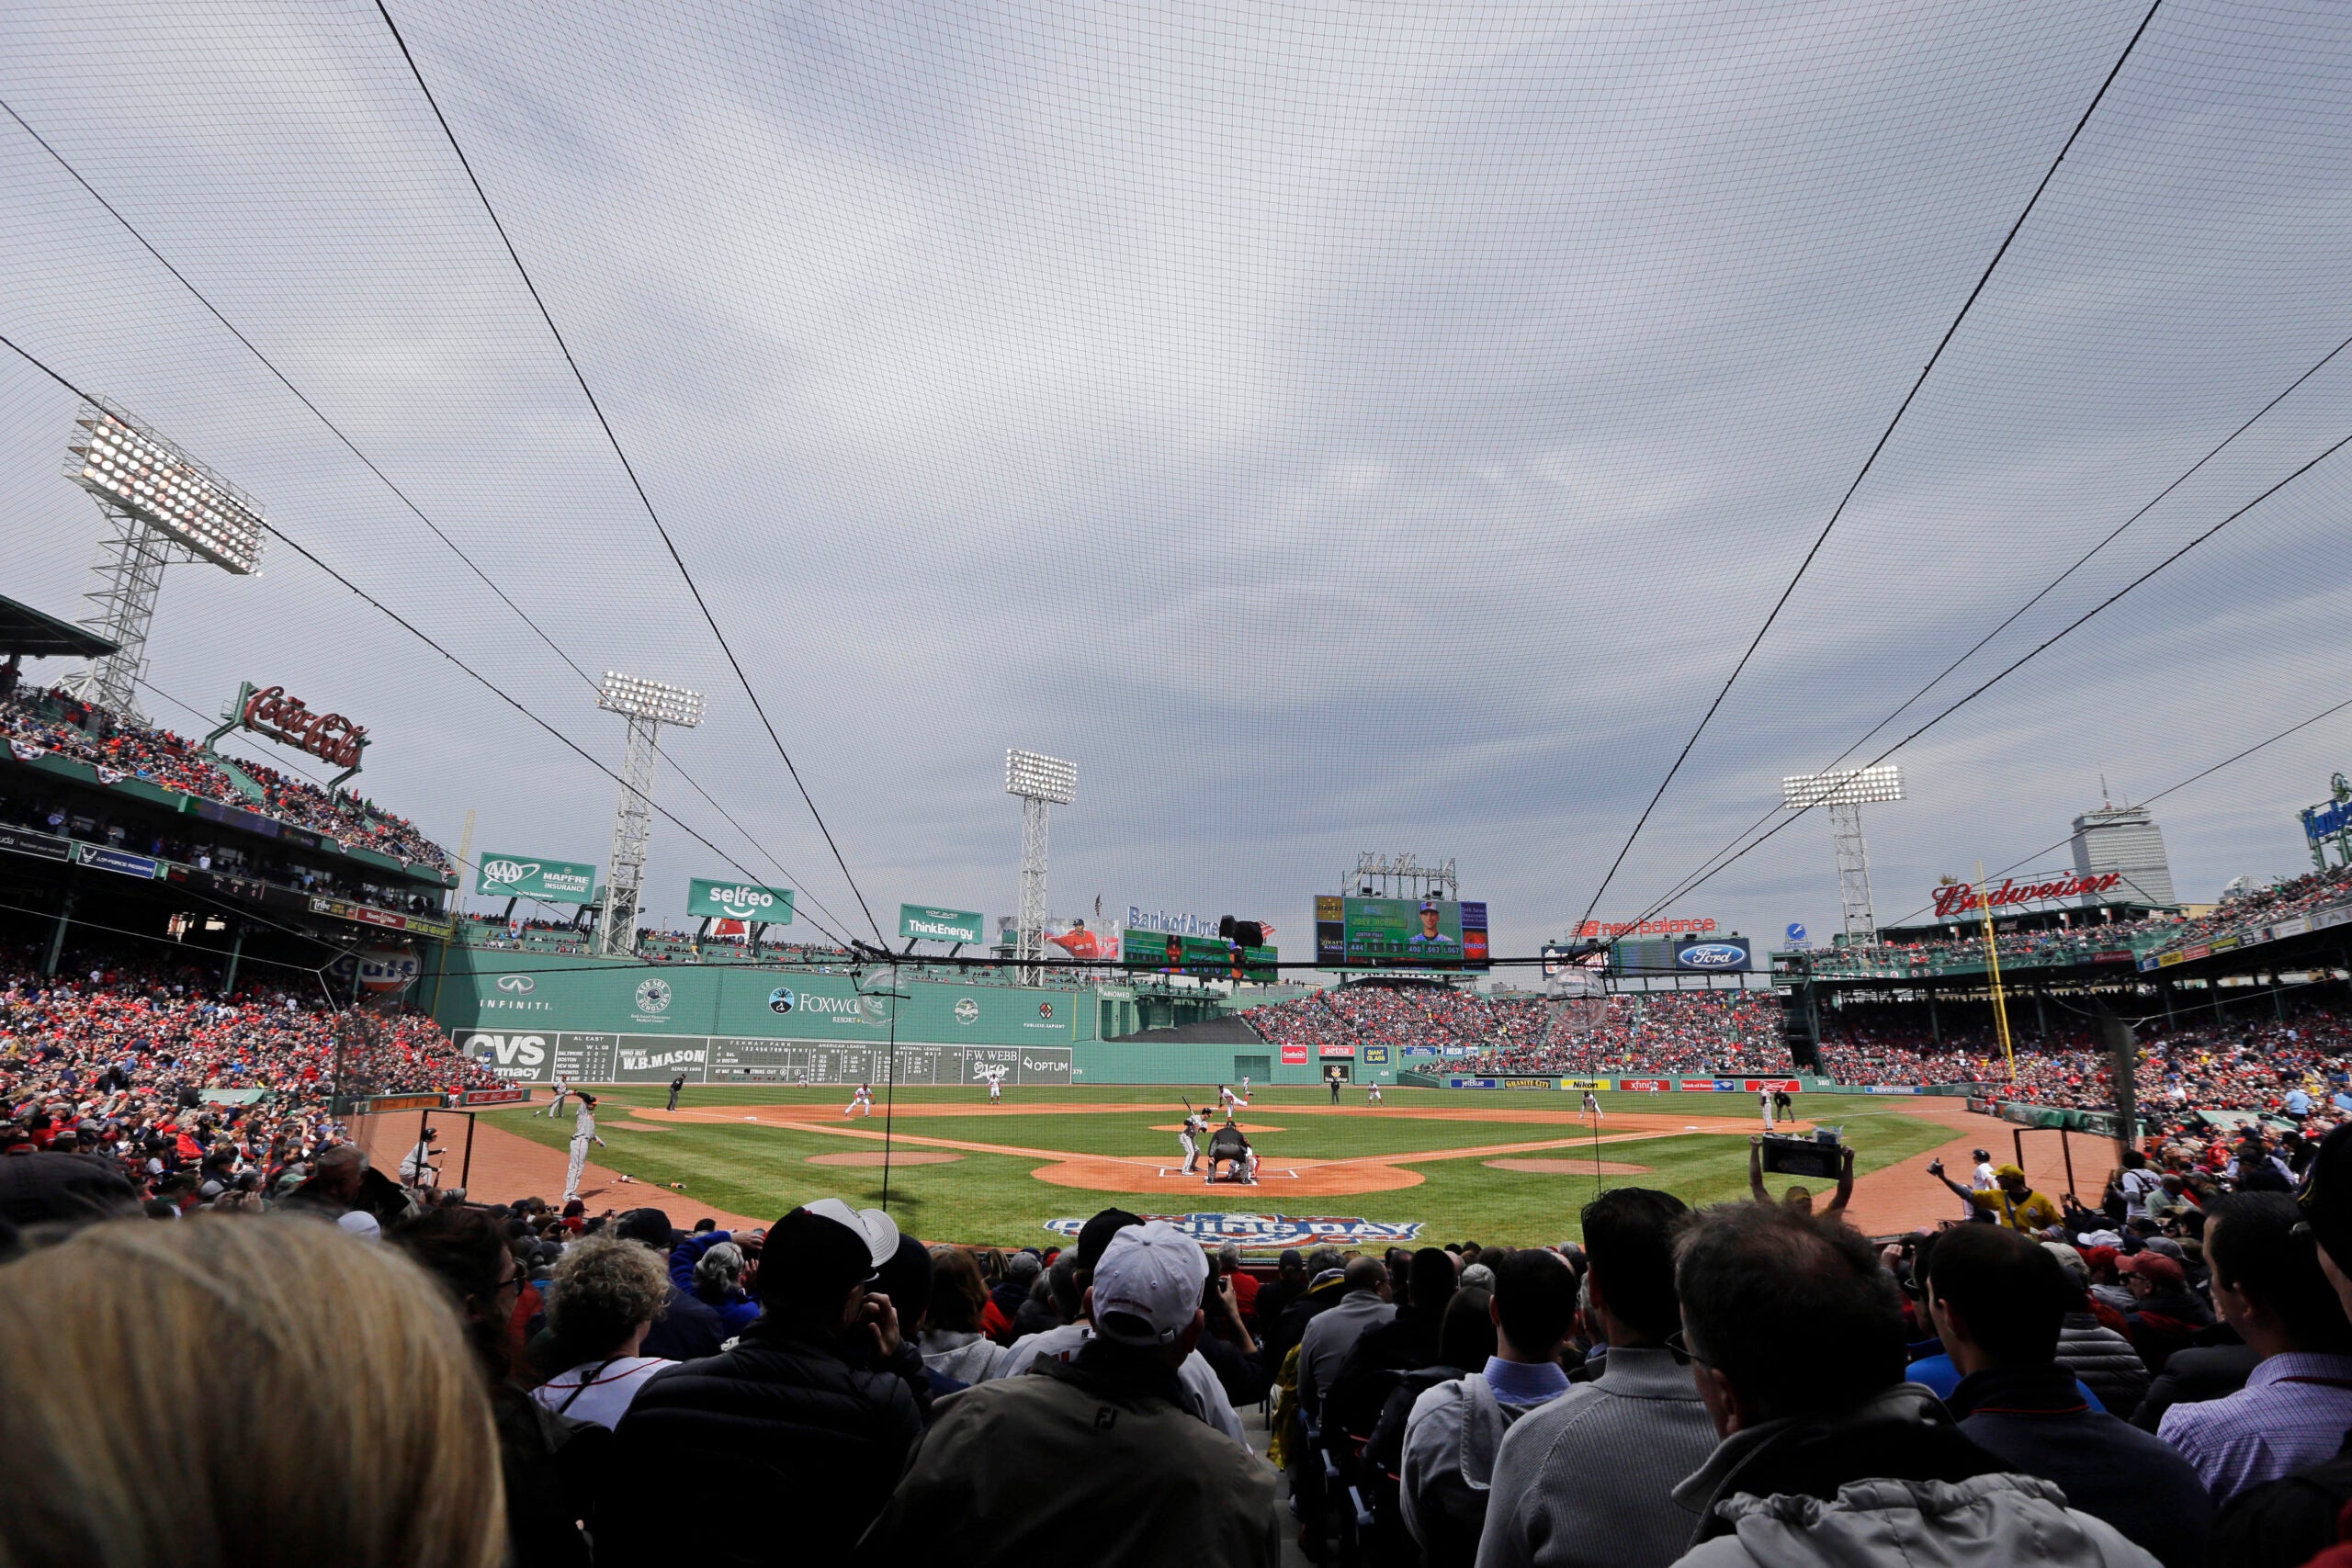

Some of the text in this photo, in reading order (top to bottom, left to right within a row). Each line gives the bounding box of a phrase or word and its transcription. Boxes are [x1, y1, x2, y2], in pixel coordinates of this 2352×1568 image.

[107, 858, 127, 867] FORCE
[127, 862, 153, 874] RESERVE
[488, 861, 517, 881] AAA
[543, 872, 589, 884] MAPFRE
[545, 883, 585, 893] INSURANCE
[1932, 871, 2121, 918] Budweiser
[312, 897, 332, 911] Tribe
[1126, 906, 1168, 931] Bank
[909, 919, 973, 940] ThinkEnergy
[1692, 947, 1732, 964] Ford
[638, 982, 650, 995] RED
[653, 981, 667, 989] SOX
[480, 999, 549, 1010] INFINITI
[638, 993, 670, 1011] SCHOLARS
[463, 1033, 546, 1066] CVS
[966, 1050, 1017, 1061] F.W. WEBB
[1035, 1062, 1068, 1071] OPTUM
[1462, 1079, 1485, 1088] jetBlue
[1309, 1223, 1419, 1235] DAY
